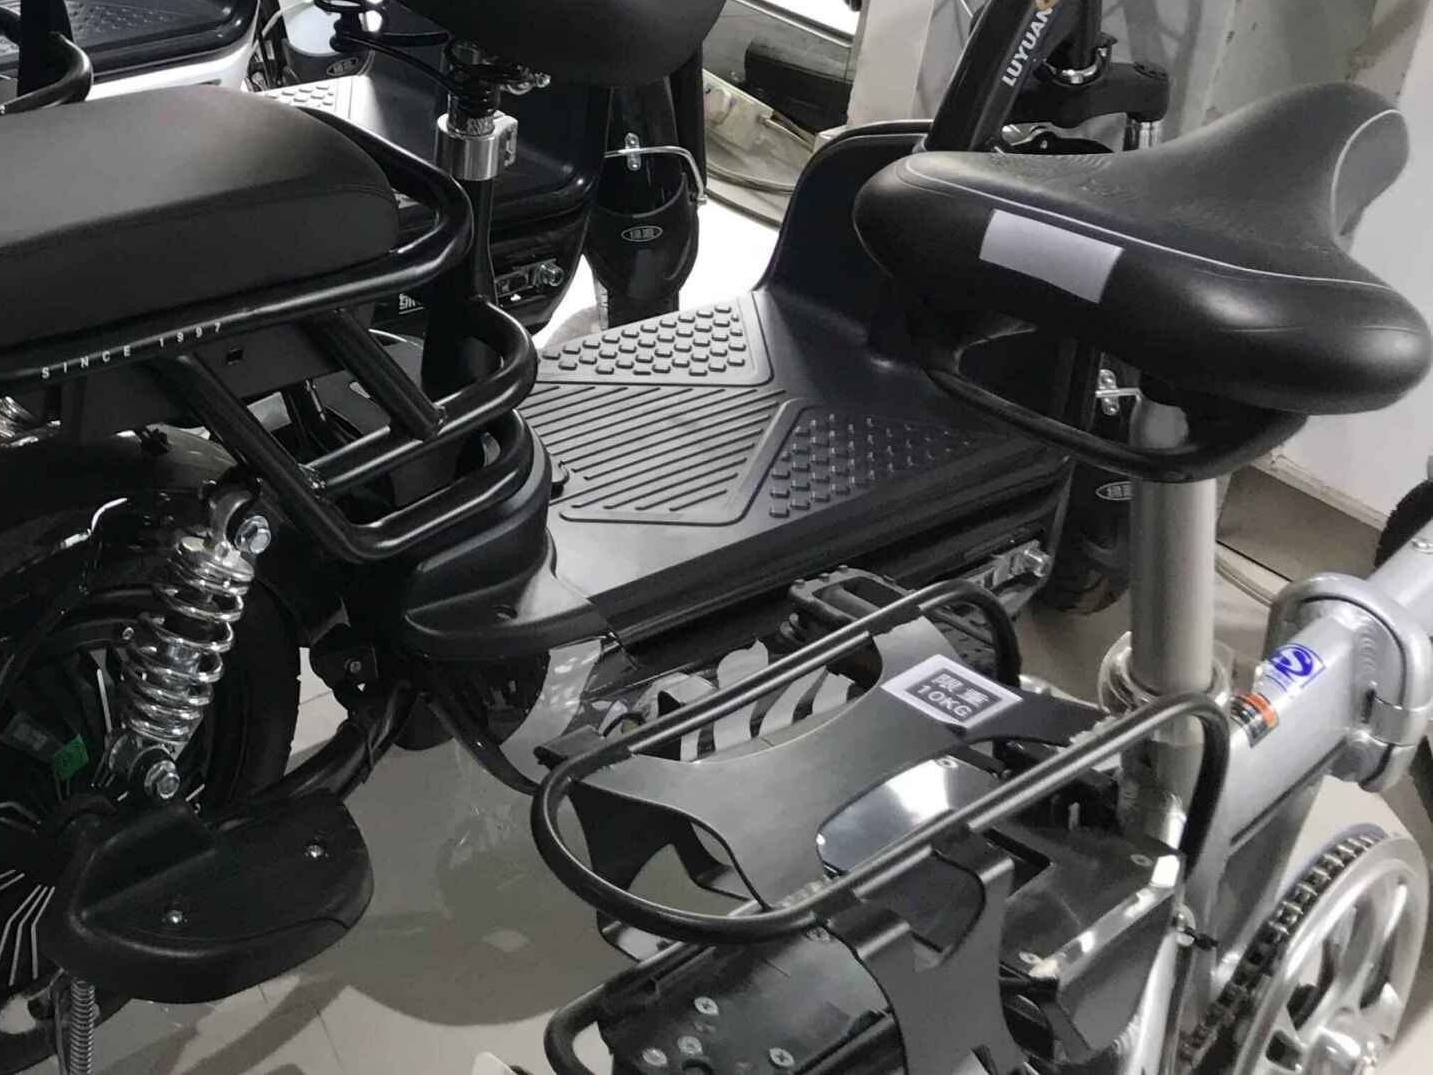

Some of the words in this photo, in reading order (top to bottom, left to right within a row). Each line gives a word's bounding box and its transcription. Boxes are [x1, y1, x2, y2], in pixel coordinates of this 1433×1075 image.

[41, 344, 131, 379] SINCE
[158, 322, 221, 348] 1997
[917, 684, 973, 719] 10KG
[930, 672, 990, 709] 限重
